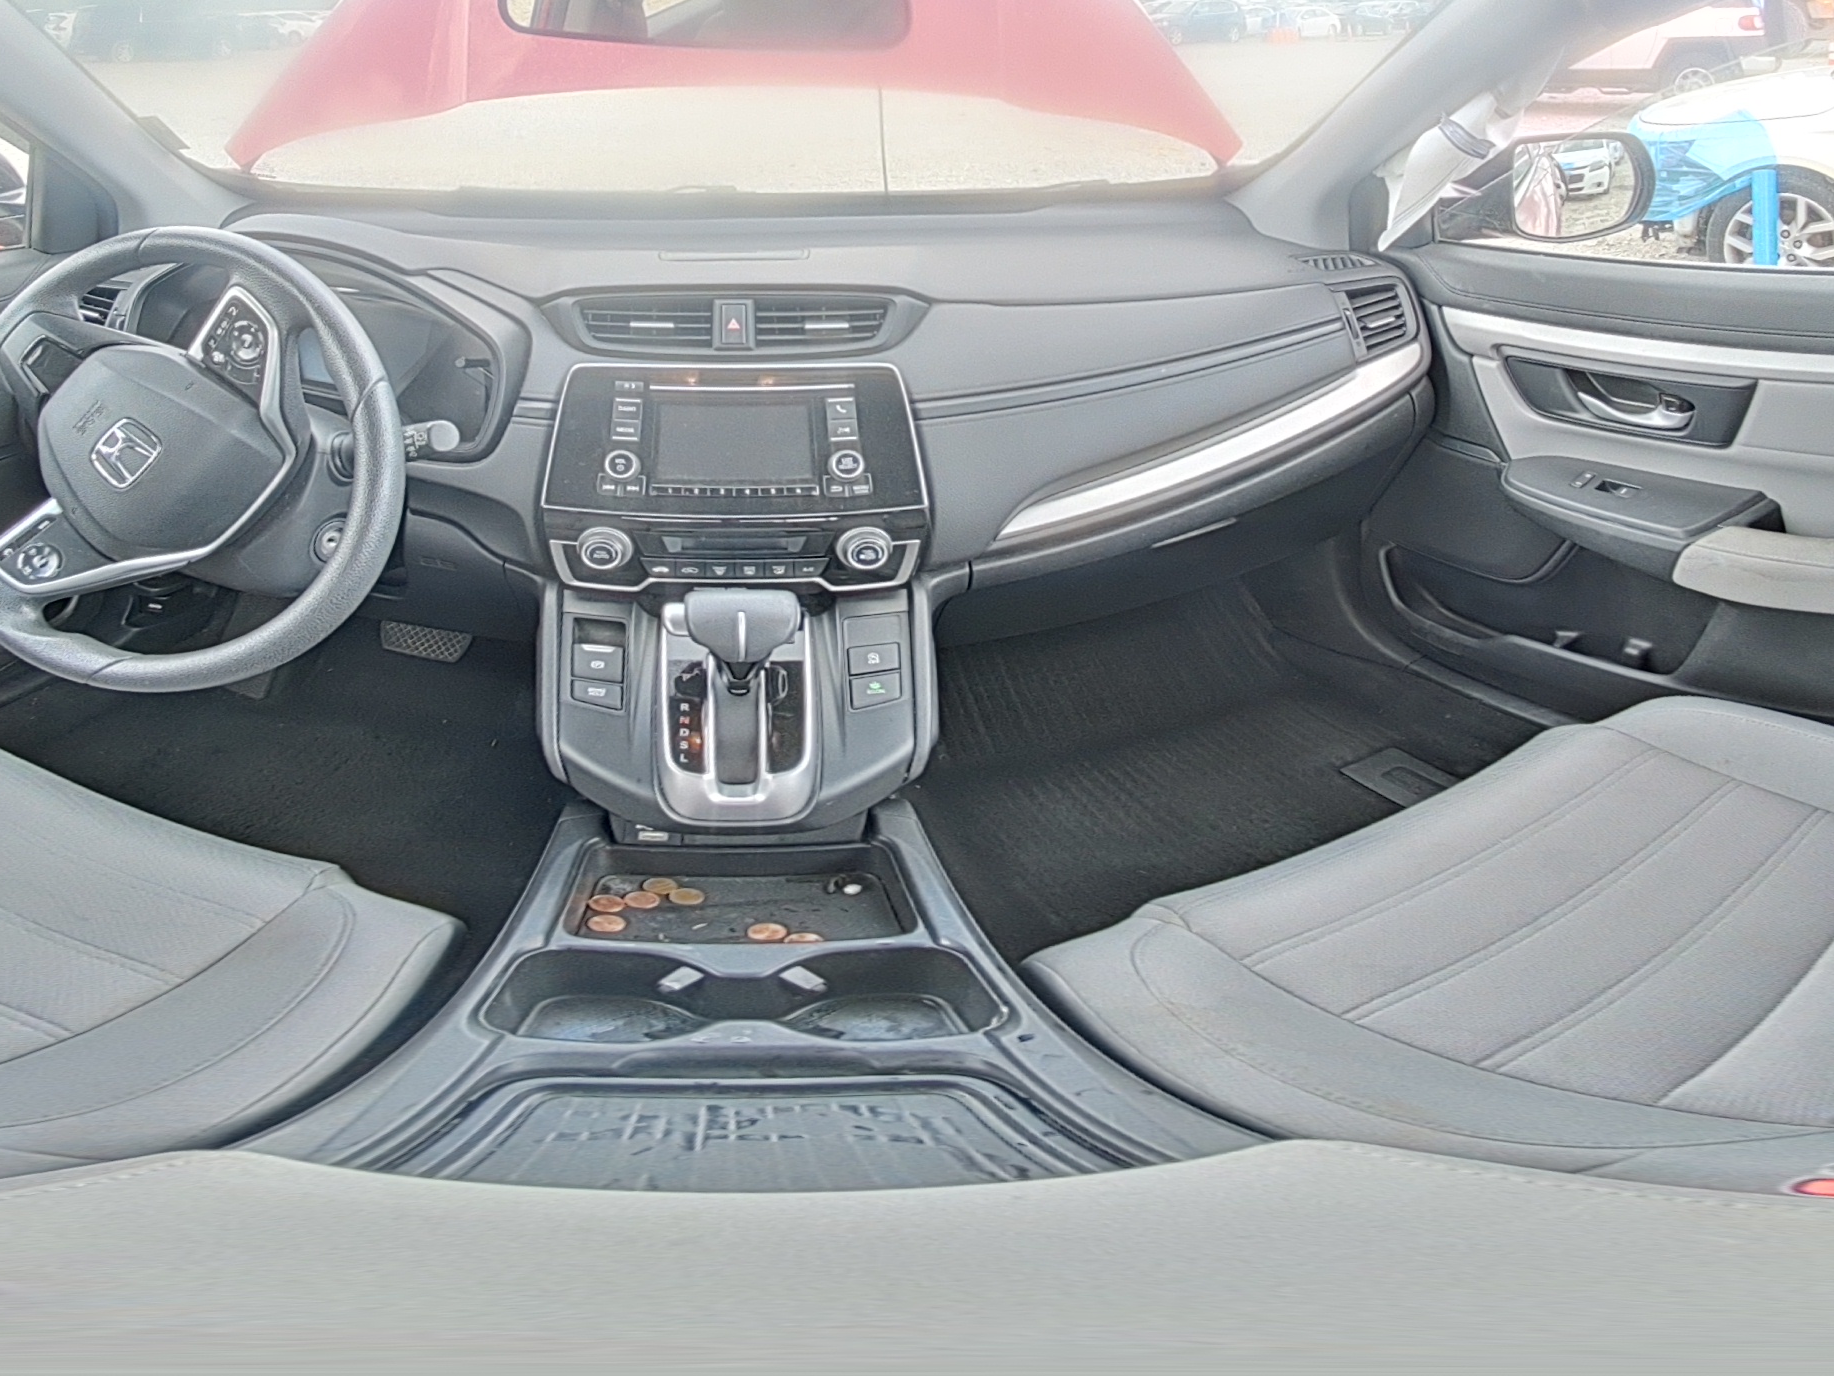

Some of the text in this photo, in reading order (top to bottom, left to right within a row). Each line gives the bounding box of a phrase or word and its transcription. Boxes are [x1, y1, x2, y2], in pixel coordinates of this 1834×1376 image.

[680, 703, 690, 712] R
[679, 715, 690, 725] N
[679, 728, 690, 737] D
[679, 740, 689, 749] S
[679, 753, 689, 763] L
